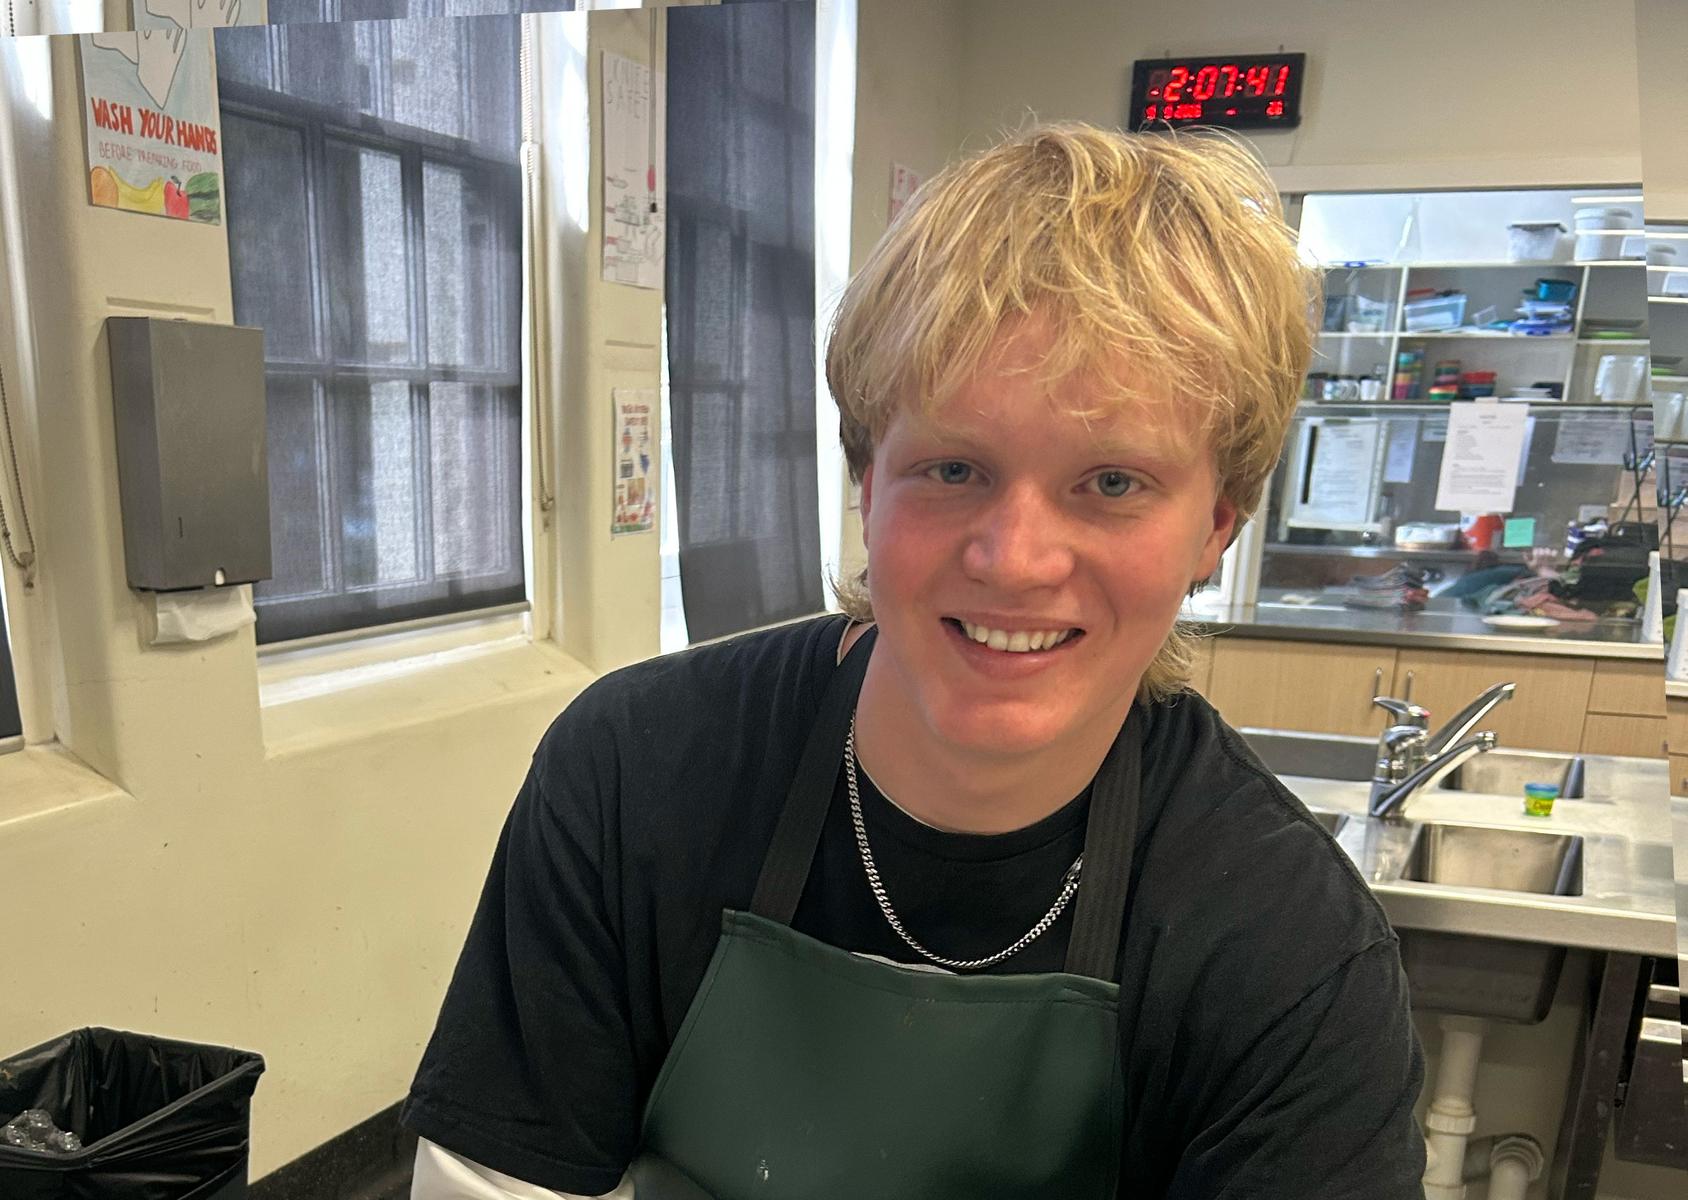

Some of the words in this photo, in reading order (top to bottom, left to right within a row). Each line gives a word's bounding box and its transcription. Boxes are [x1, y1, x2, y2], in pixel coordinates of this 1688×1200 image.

[91, 97, 133, 135] WASH
[138, 108, 175, 145] YOUR
[176, 120, 217, 155] HANDS
[99, 142, 132, 161] BEFORE
